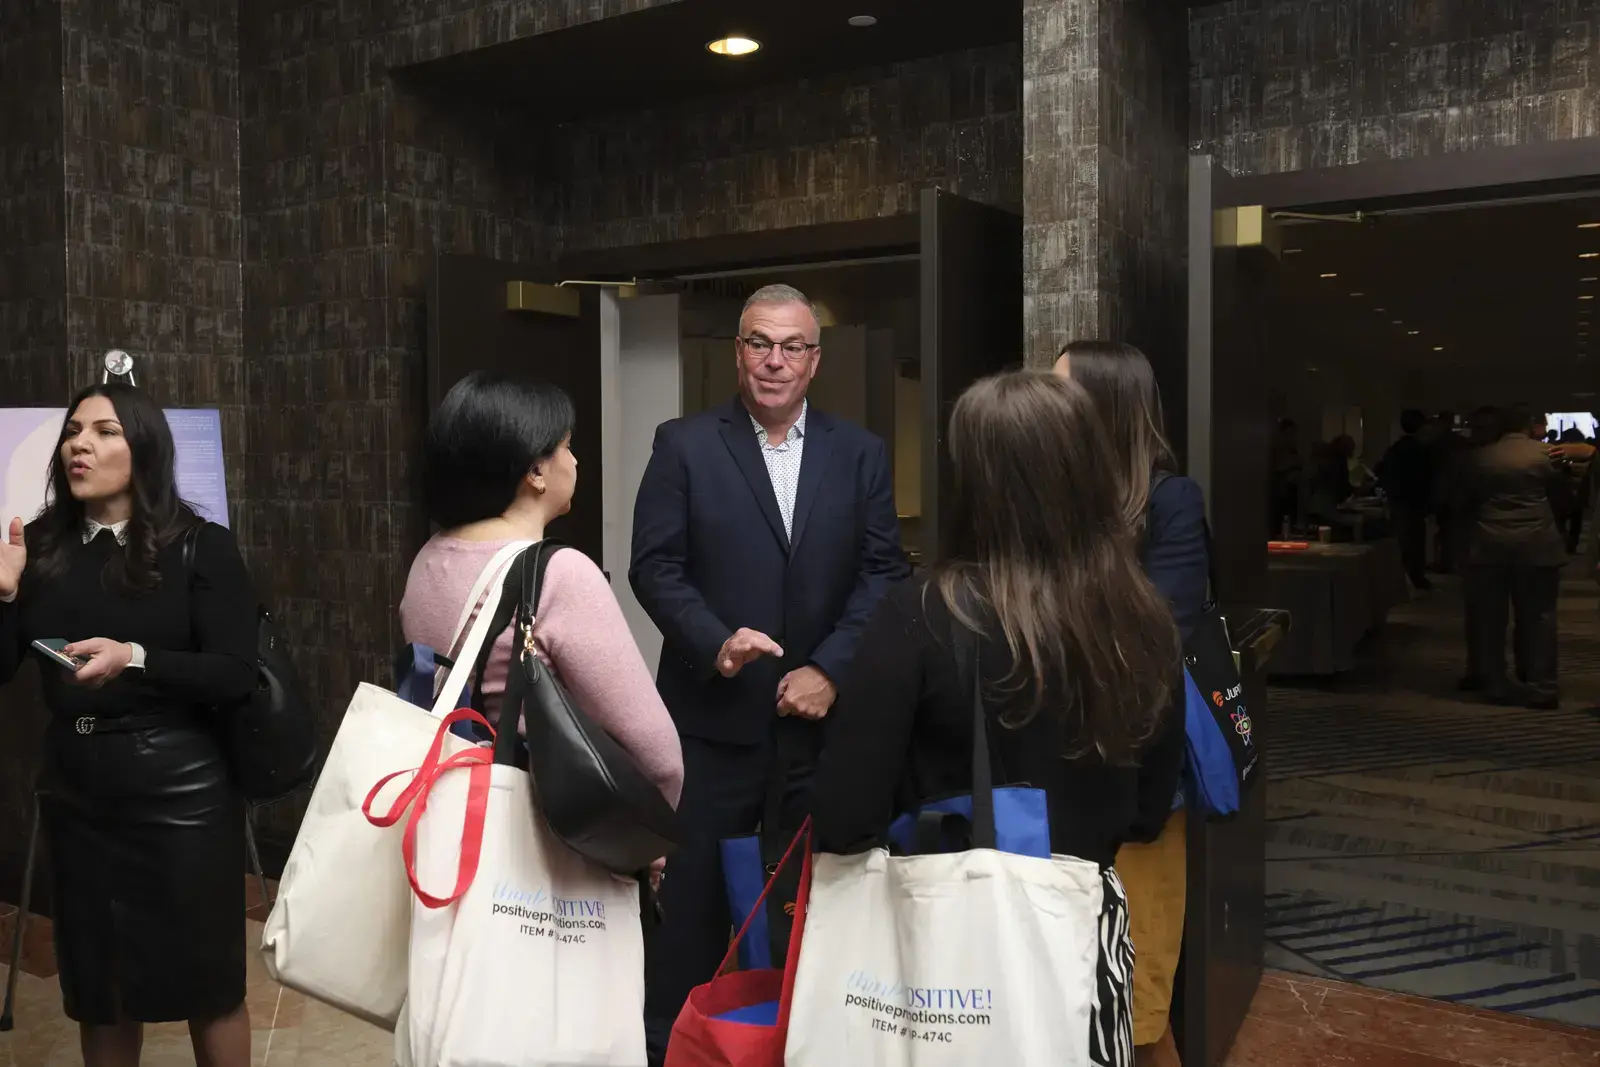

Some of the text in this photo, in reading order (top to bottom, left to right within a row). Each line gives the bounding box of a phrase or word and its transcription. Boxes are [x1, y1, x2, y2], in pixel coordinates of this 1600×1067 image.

[552, 896, 607, 920] OSITIVE!
[520, 924, 545, 937] ITEM
[906, 987, 993, 1009] OSITIVE!
[871, 1018, 898, 1035] ITEM
